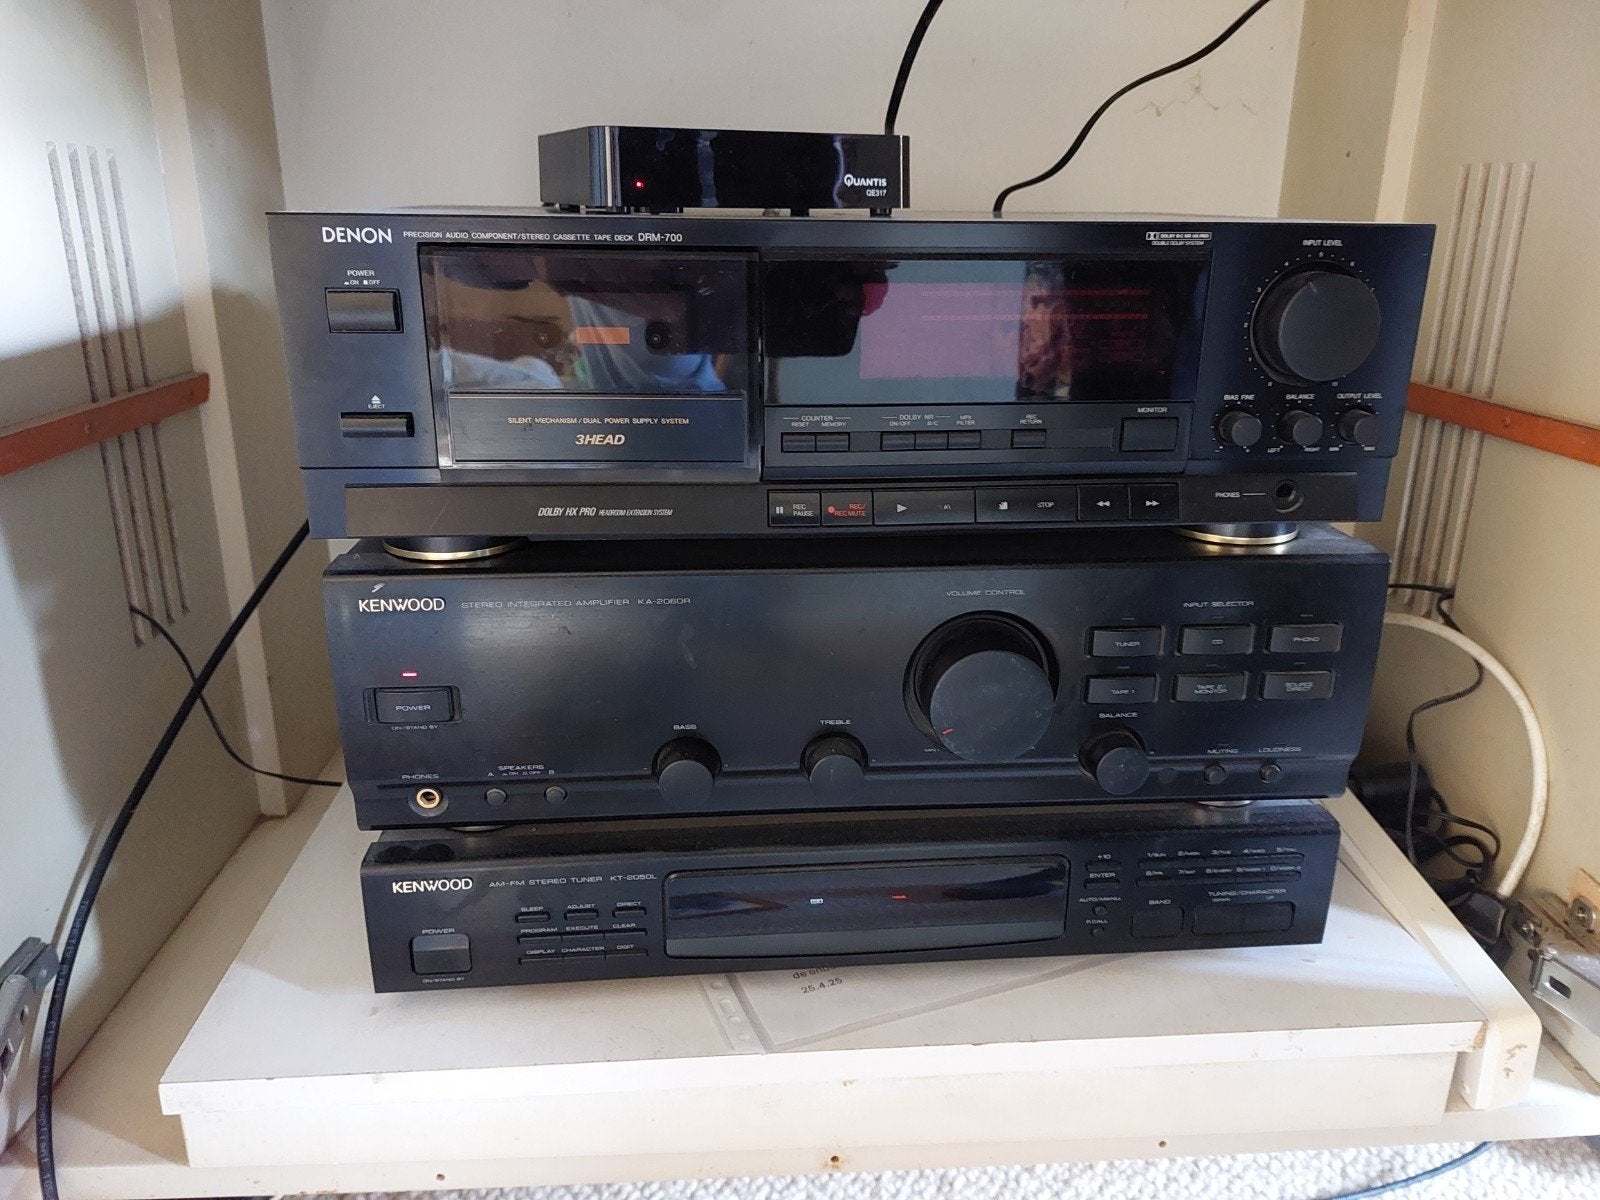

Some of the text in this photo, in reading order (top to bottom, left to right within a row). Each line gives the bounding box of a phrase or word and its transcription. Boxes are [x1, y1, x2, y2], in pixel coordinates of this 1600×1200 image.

[844, 174, 887, 187] QUANTIS
[866, 189, 887, 197] QE317
[322, 227, 392, 244] DENON
[403, 231, 443, 239] PRECISION
[471, 232, 550, 240] COMPONENT/STEREO
[638, 233, 683, 242] DRM-700
[575, 434, 626, 445] 3HEAD
[538, 507, 565, 516] DOLBY
[565, 508, 578, 516] HX
[579, 507, 596, 516] PRO
[358, 598, 445, 613] KENWOOD
[507, 600, 572, 608] INTEGRATED
[575, 599, 629, 607] AMPLIFIER
[570, 876, 603, 884] TUNER
[392, 878, 473, 894] KENWOOD
[792, 971, 808, 979] de
[802, 977, 843, 994] 25.4.25
